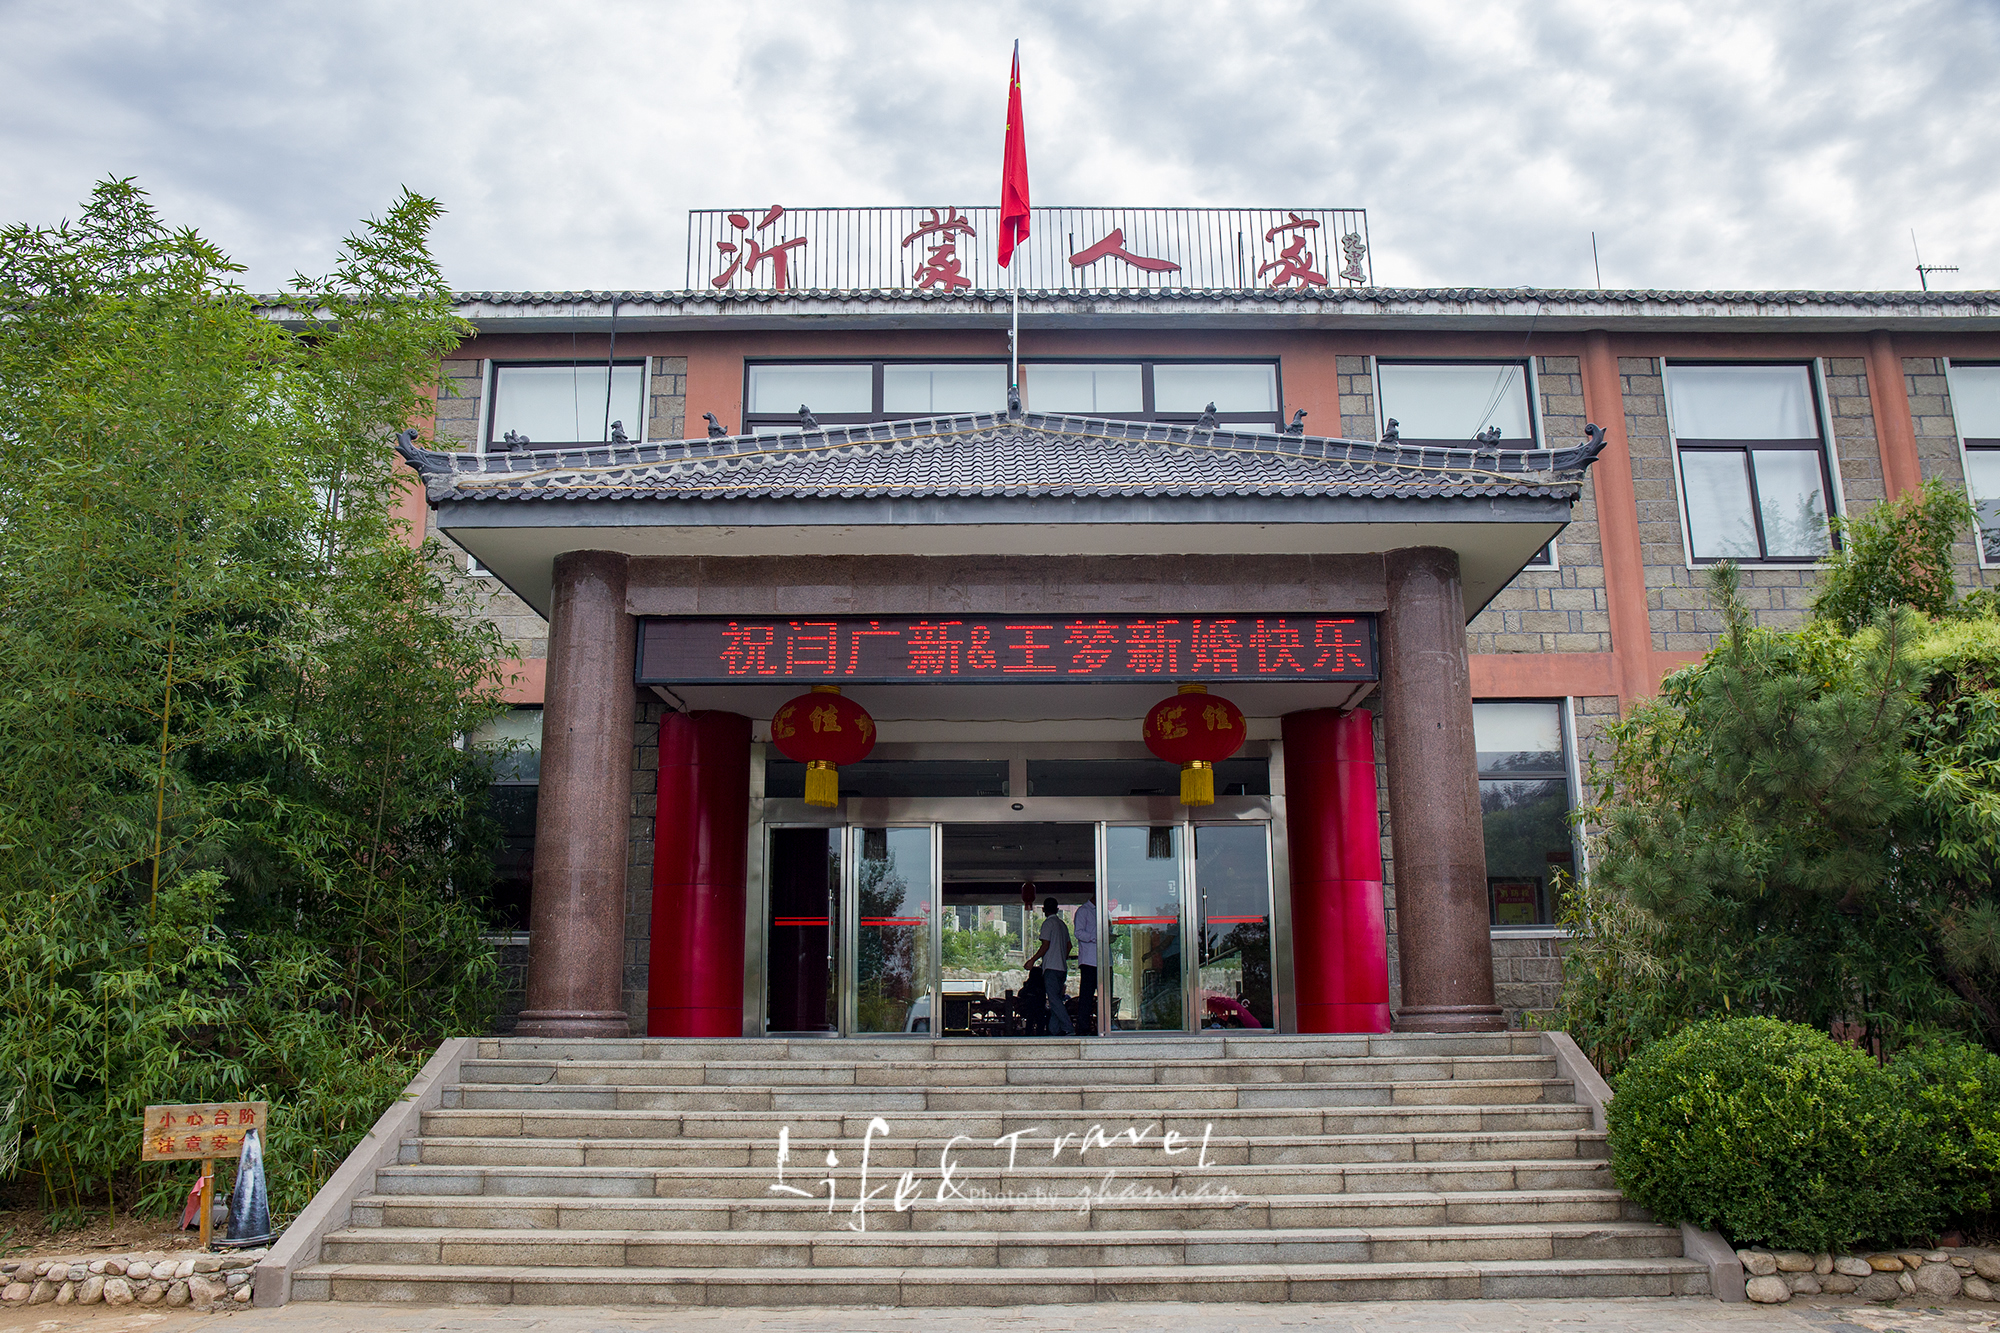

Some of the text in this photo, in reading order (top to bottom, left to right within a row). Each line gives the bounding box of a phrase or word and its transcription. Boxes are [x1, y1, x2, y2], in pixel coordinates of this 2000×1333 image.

[712, 205, 1329, 293] 沂蒙人家
[720, 619, 1366, 674] 祝闫广新&王梦新婚快乐
[159, 1108, 257, 1129] 小心台阶
